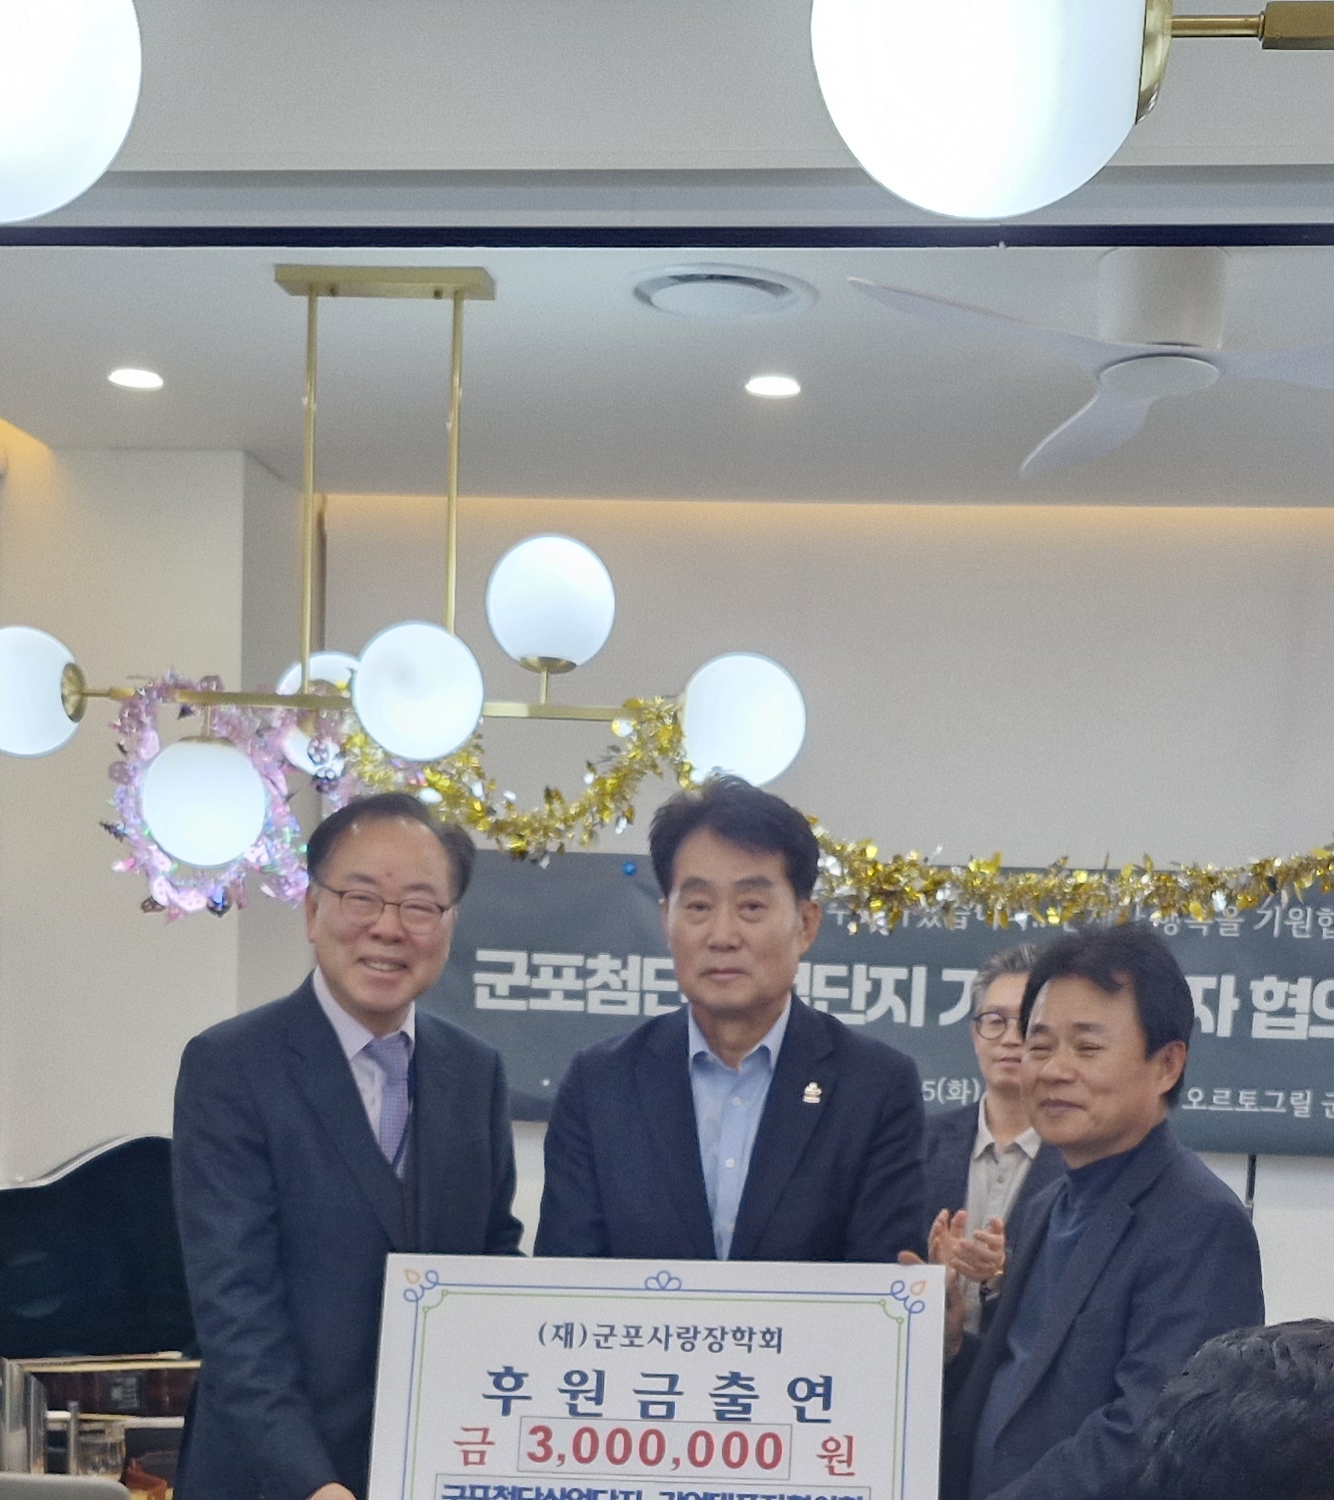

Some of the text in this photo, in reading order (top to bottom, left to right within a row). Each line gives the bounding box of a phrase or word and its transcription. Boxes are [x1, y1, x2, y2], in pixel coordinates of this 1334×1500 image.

[1181, 1087, 1312, 1118] 오르토그릴
[537, 1321, 784, 1355] (재)군포사랑장학회
[453, 1424, 856, 1477] 금 3,000,000 원
